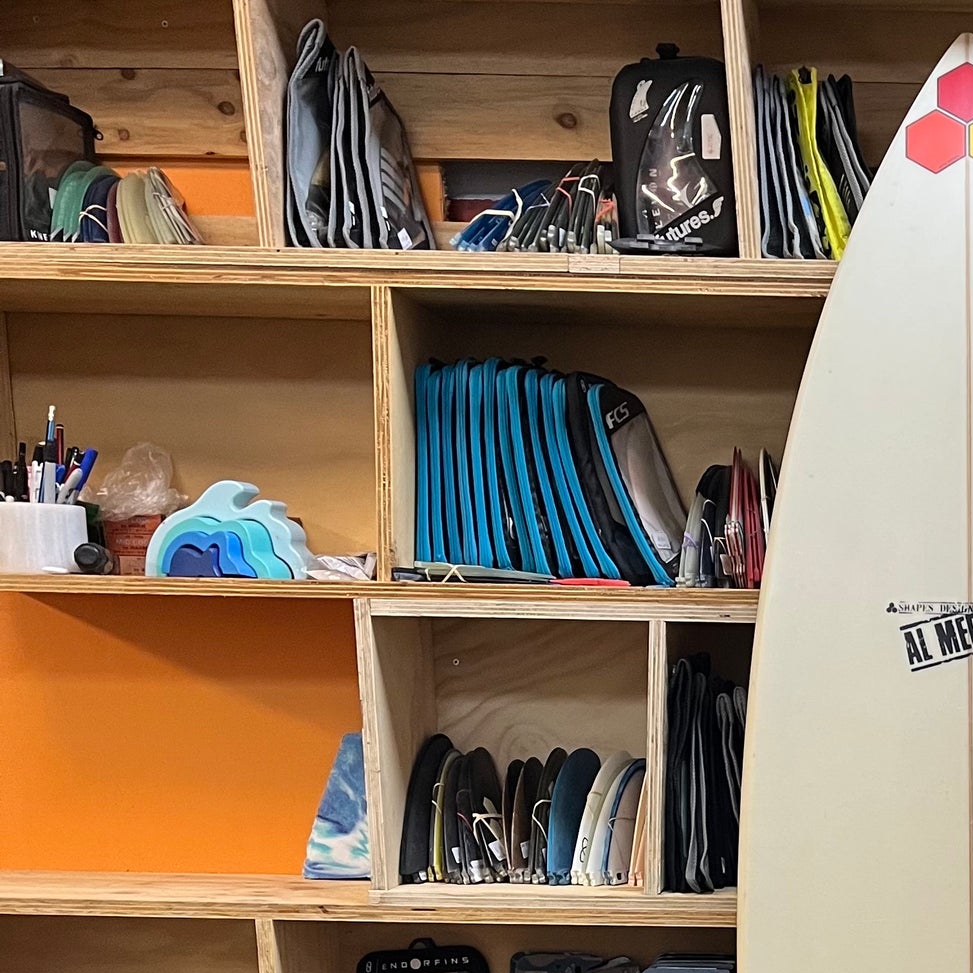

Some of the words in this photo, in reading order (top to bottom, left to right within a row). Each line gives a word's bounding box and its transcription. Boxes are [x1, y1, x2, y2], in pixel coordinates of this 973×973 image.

[606, 402, 629, 429] FCS
[899, 603, 934, 612] SHAPES
[904, 628, 933, 665] AL
